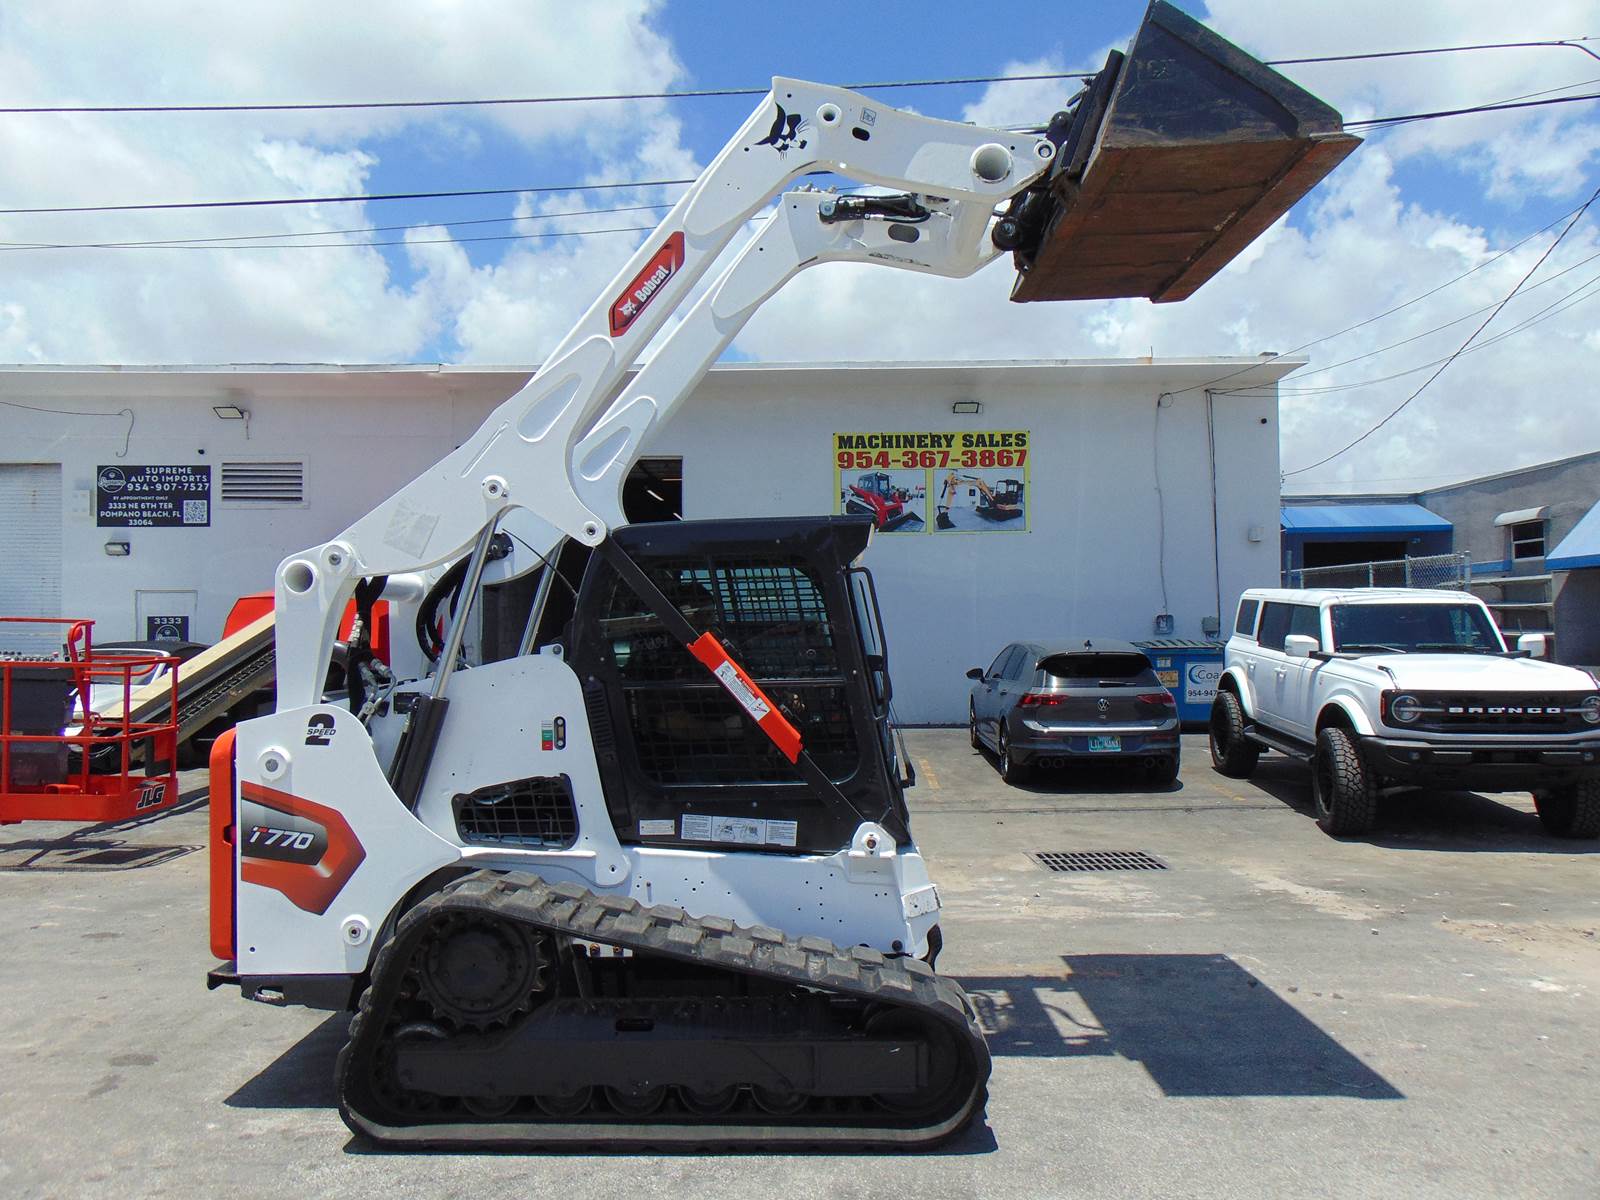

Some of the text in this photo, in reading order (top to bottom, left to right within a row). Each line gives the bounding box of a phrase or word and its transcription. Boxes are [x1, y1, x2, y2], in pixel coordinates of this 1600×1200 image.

[634, 264, 669, 303] Bobcat
[837, 432, 1027, 449] MACHINERY SALES
[837, 449, 1027, 469] 954-367-3867
[145, 467, 192, 475] SUPREME
[127, 483, 210, 491] 954-907-7527
[1197, 670, 1221, 680] Coa
[304, 713, 337, 746] 2 SPEED
[136, 784, 166, 810] JLG
[249, 826, 316, 850] T770
